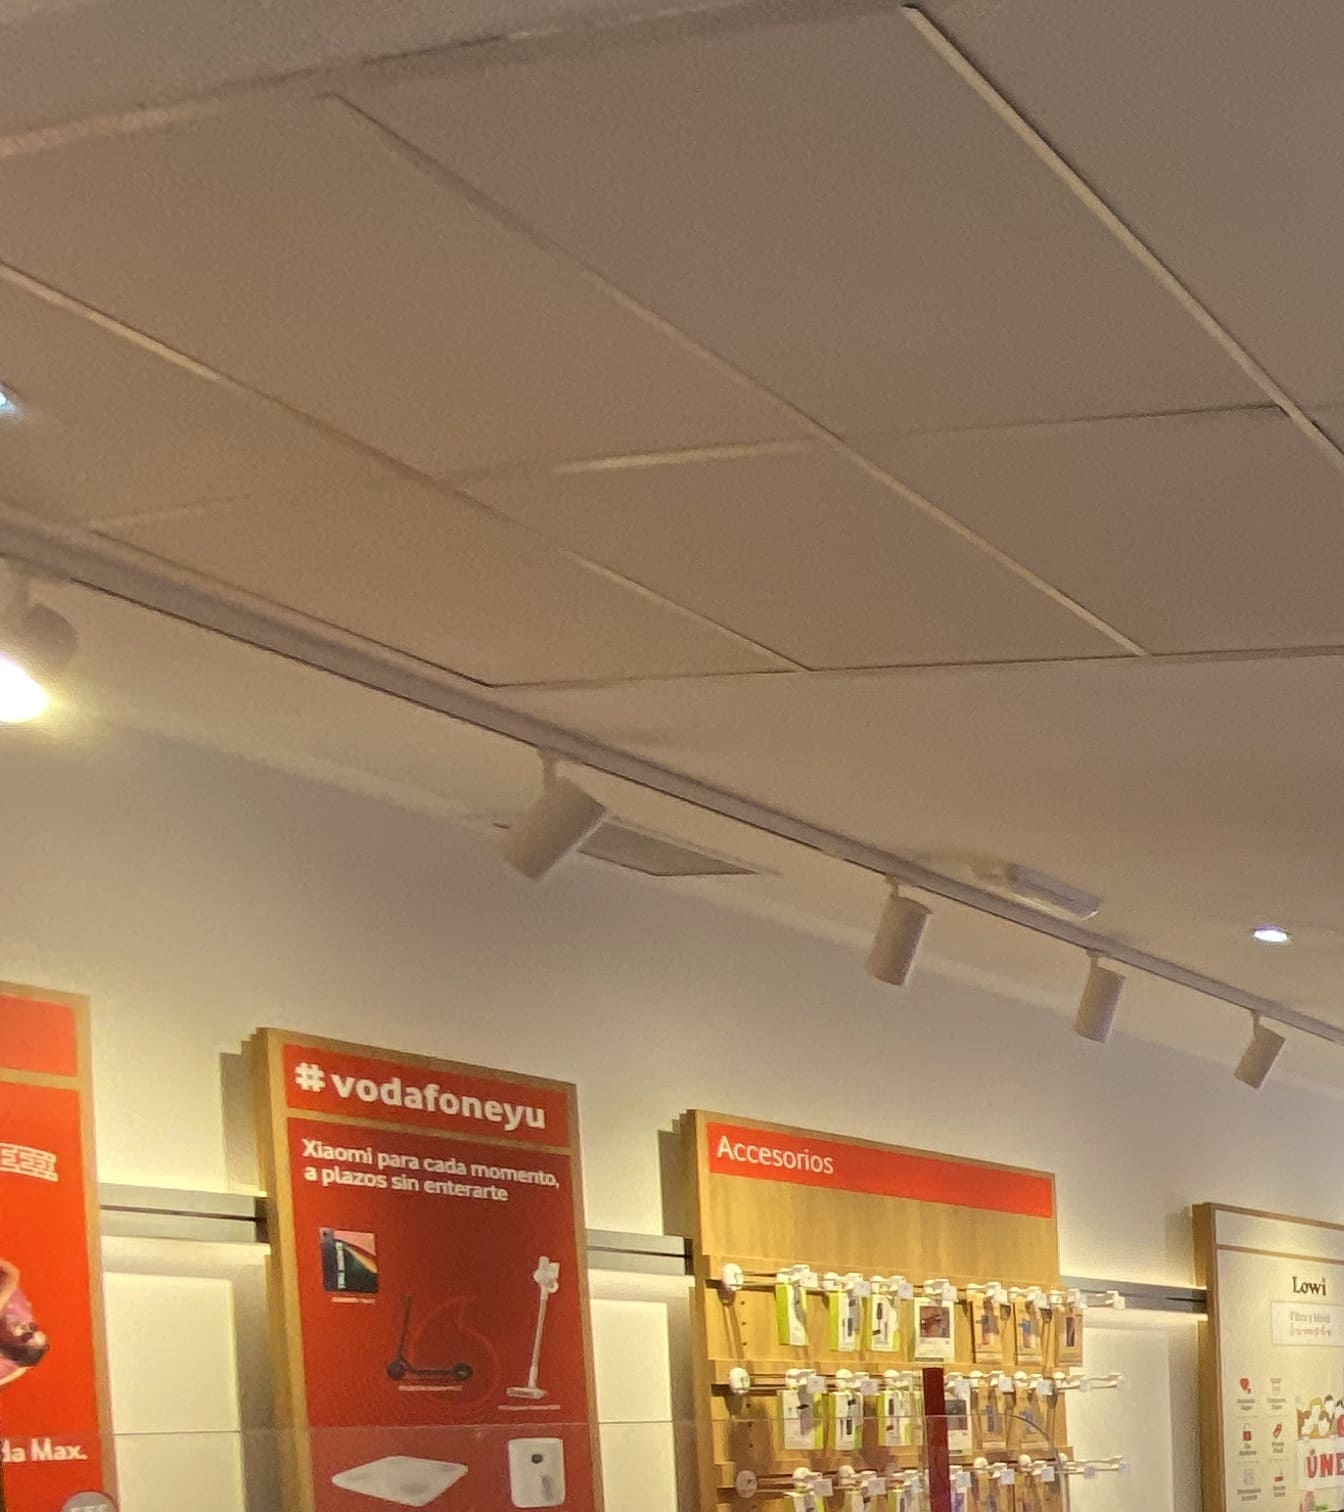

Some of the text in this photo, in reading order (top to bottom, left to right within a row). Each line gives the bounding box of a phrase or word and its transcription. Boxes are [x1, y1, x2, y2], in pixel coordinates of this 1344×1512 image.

[295, 1062, 546, 1131] #vodafoneyu
[302, 1138, 560, 1190] Xiaomi para cada momento,
[717, 1135, 834, 1174] Accesorios
[304, 1165, 510, 1202] a plazos sin enterarte
[1292, 1276, 1327, 1297] Lowi
[31, 1437, 89, 1462] Max.
